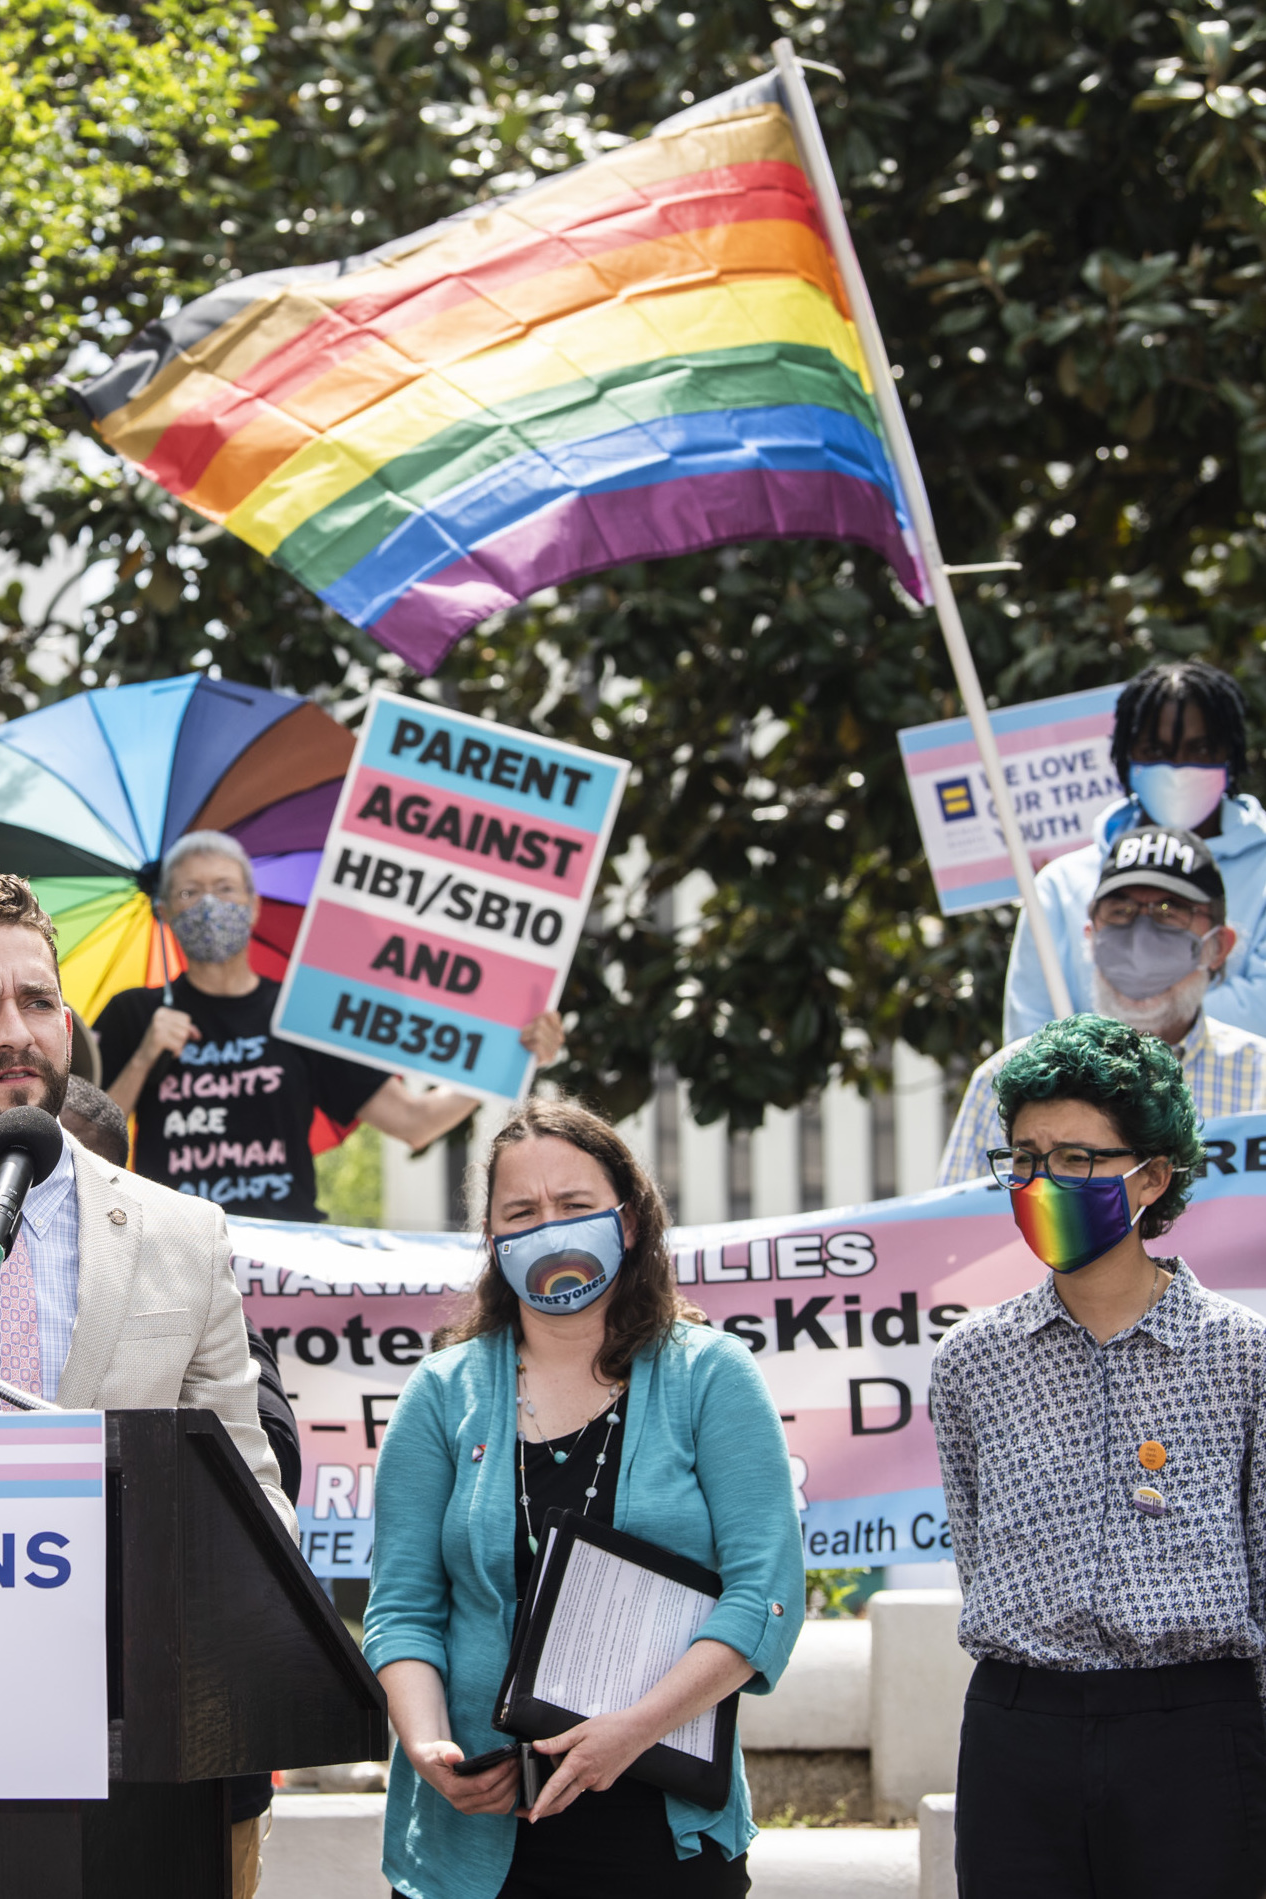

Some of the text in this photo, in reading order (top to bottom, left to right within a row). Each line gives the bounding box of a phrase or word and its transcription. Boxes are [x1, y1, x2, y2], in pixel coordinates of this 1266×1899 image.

[390, 719, 592, 806] PARENT
[1027, 750, 1096, 781] LOVE
[1049, 777, 1124, 807] TRAN
[357, 785, 582, 878] AGAINST
[1116, 833, 1194, 874] BHM
[332, 848, 563, 946] HB1/SB10
[371, 935, 482, 995] AND
[180, 1035, 268, 1066] RANS
[331, 993, 484, 1072] HB391
[159, 1066, 283, 1102] RIGHTS
[164, 1106, 227, 1138] ARE
[168, 1139, 286, 1174] HUMAN
[529, 1277, 600, 1305] everyone
[262, 1314, 432, 1366] rote
